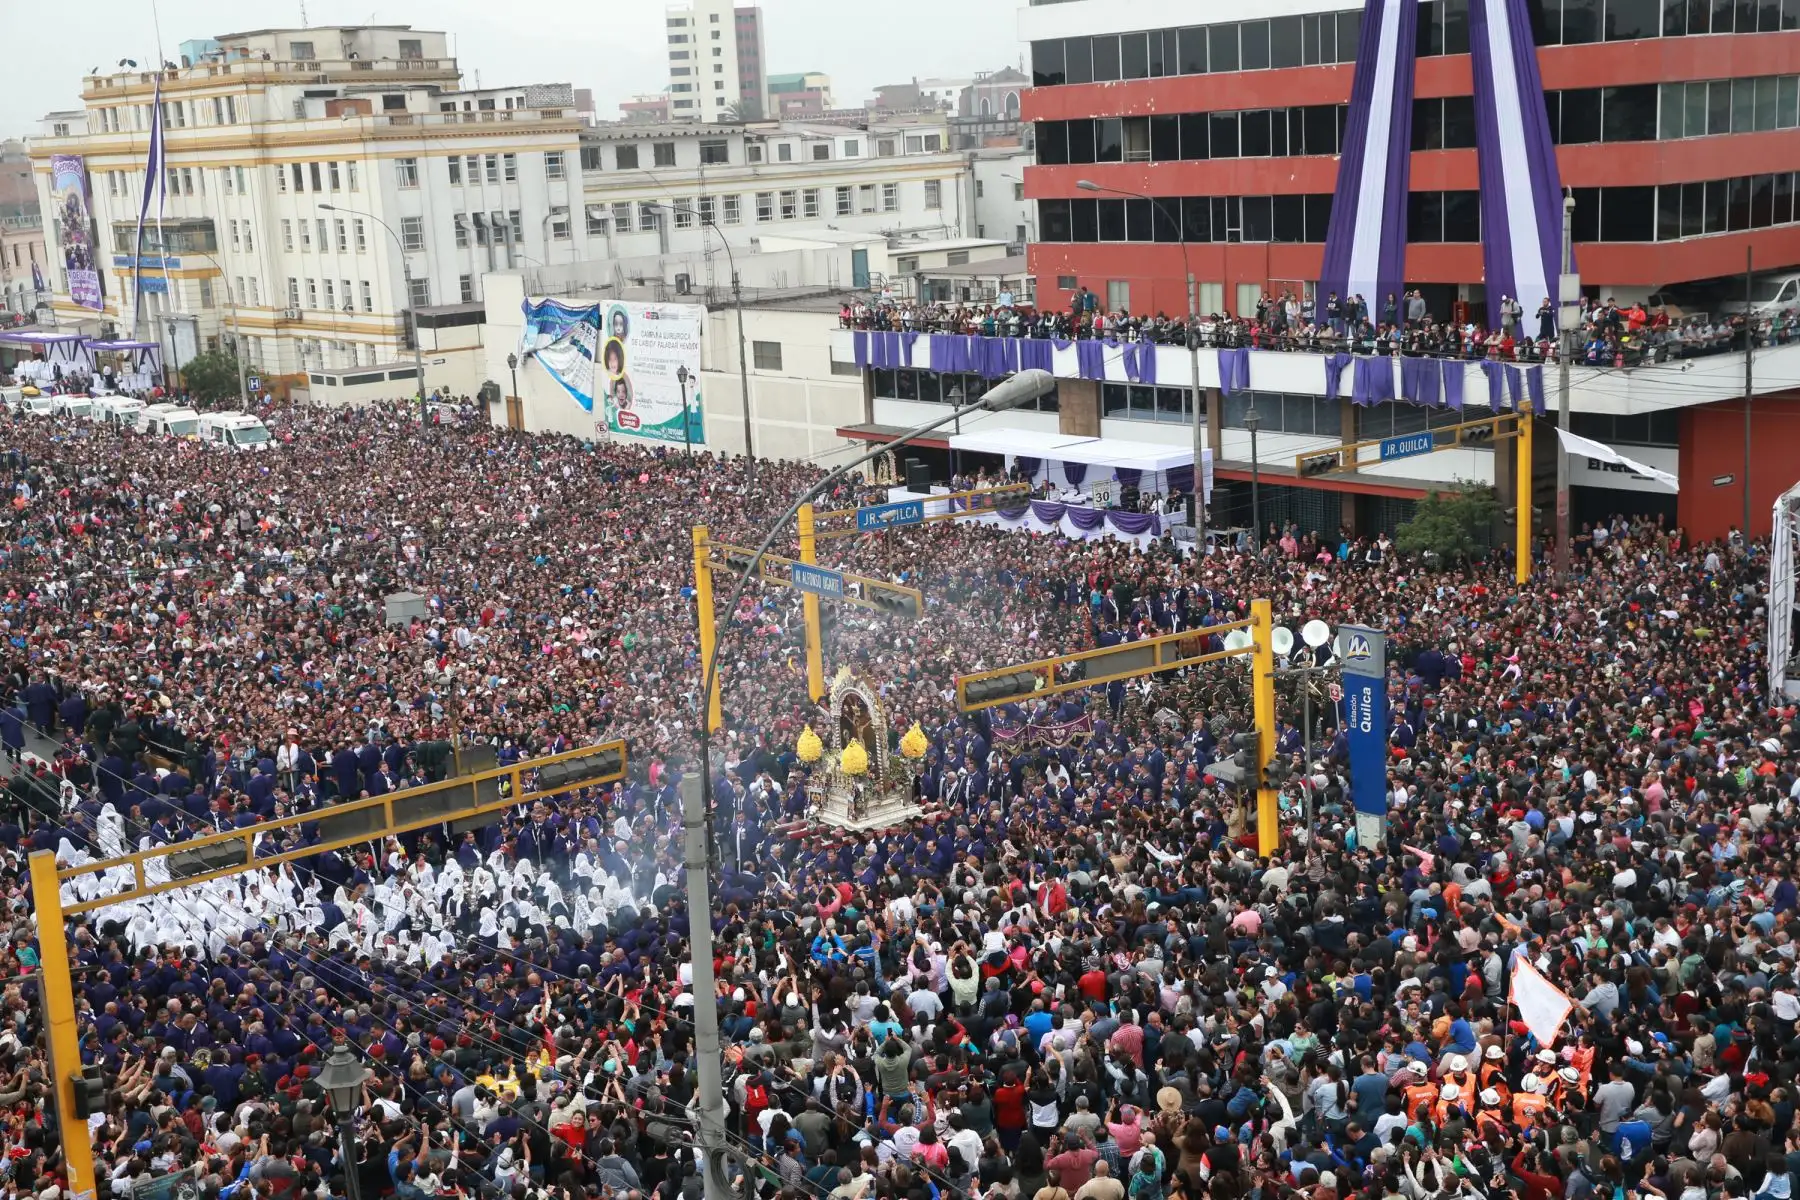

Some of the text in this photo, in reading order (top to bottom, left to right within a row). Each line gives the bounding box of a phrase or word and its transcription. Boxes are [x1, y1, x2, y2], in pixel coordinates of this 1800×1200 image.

[250, 378, 259, 389] H
[1385, 437, 1428, 456] JR. QUILCA
[1588, 457, 1600, 470] El
[1095, 491, 1110, 502] 30
[863, 506, 918, 526] JR. ILCA
[802, 571, 821, 588] ALFONSO
[823, 575, 839, 593] UGARTE
[1360, 686, 1372, 733] Quilca
